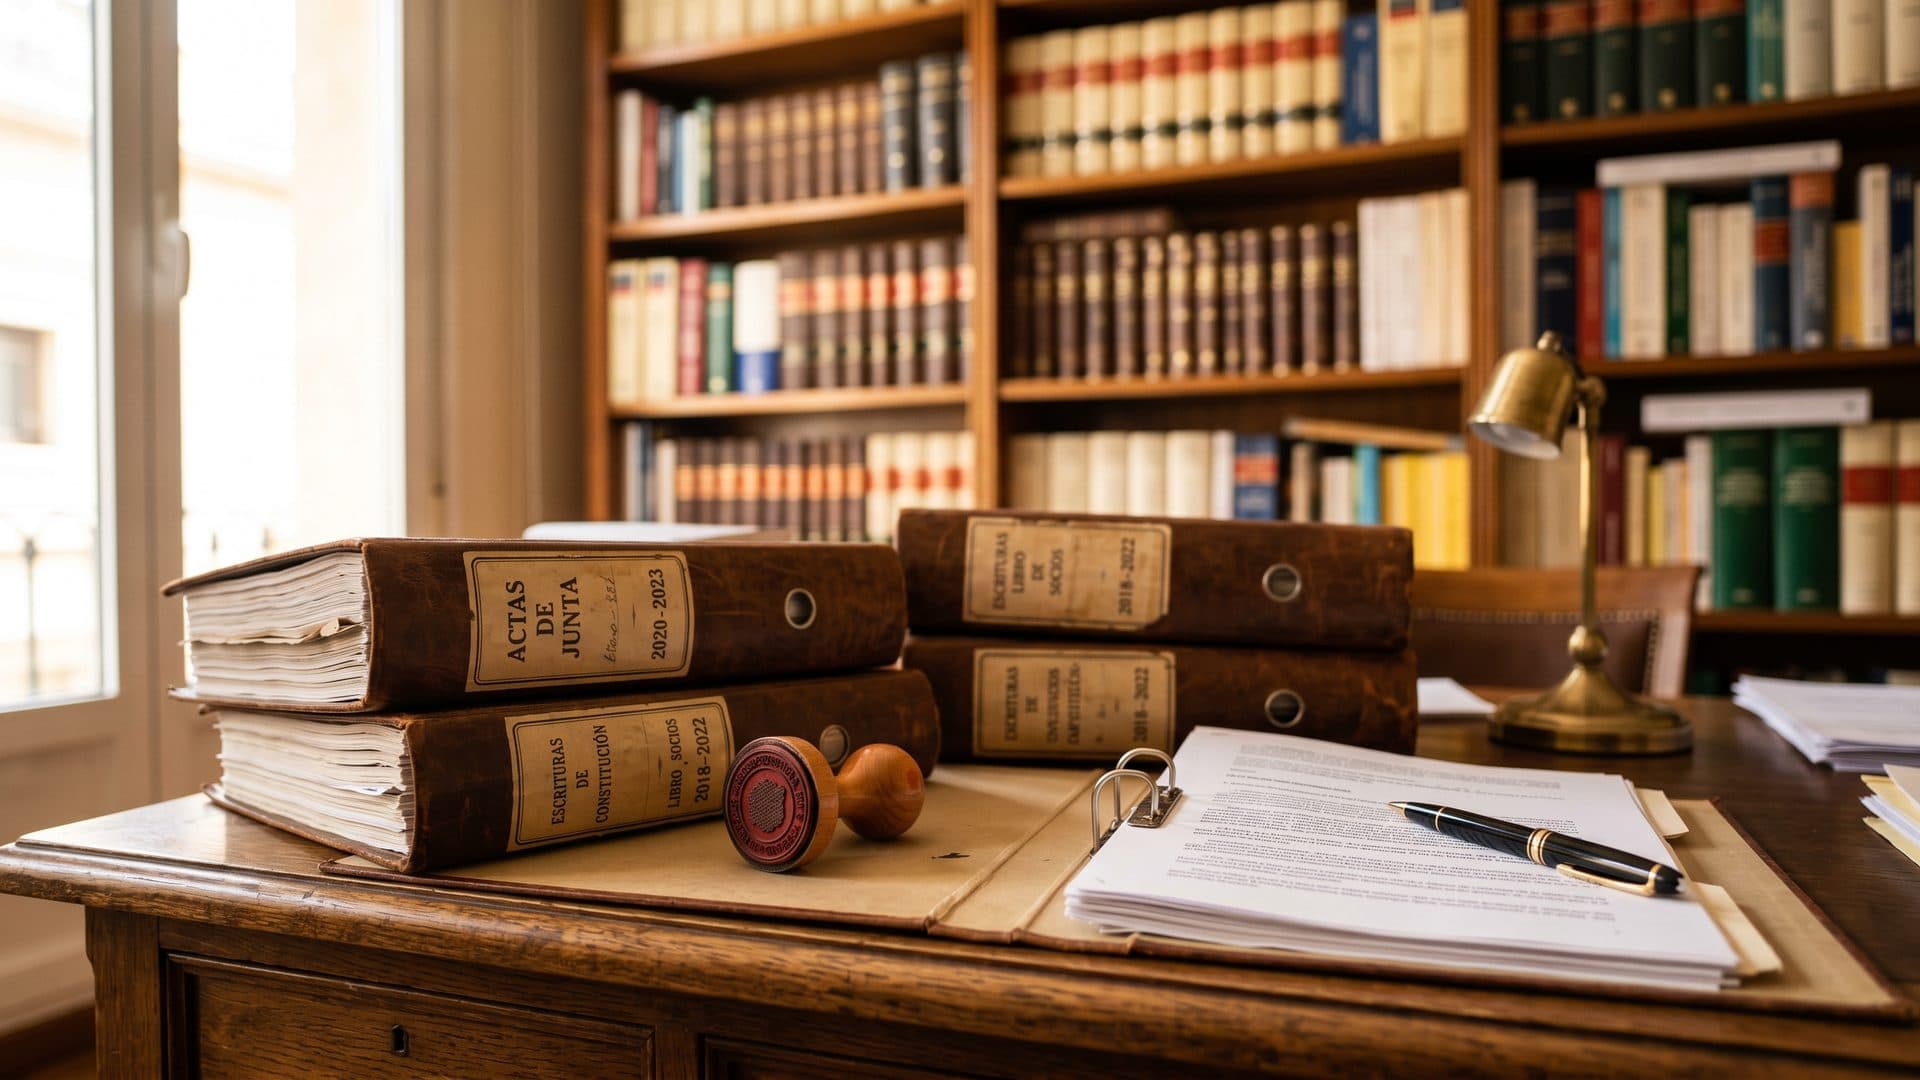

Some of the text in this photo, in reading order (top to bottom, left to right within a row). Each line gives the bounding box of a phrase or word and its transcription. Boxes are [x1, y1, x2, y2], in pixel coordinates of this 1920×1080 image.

[1012, 551, 1026, 594] LIBRO
[1032, 564, 1044, 581] DE
[1049, 548, 1064, 596] SOCIOS
[505, 580, 527, 663] ACTAS
[536, 602, 554, 636] DE
[560, 576, 581, 659] JUNTA
[550, 737, 567, 825] ESCRITURAS
[576, 769, 589, 789] DE
[592, 724, 612, 824] CONSTITUCIÓN
[665, 718, 682, 809] LIBRO SOCIOS
